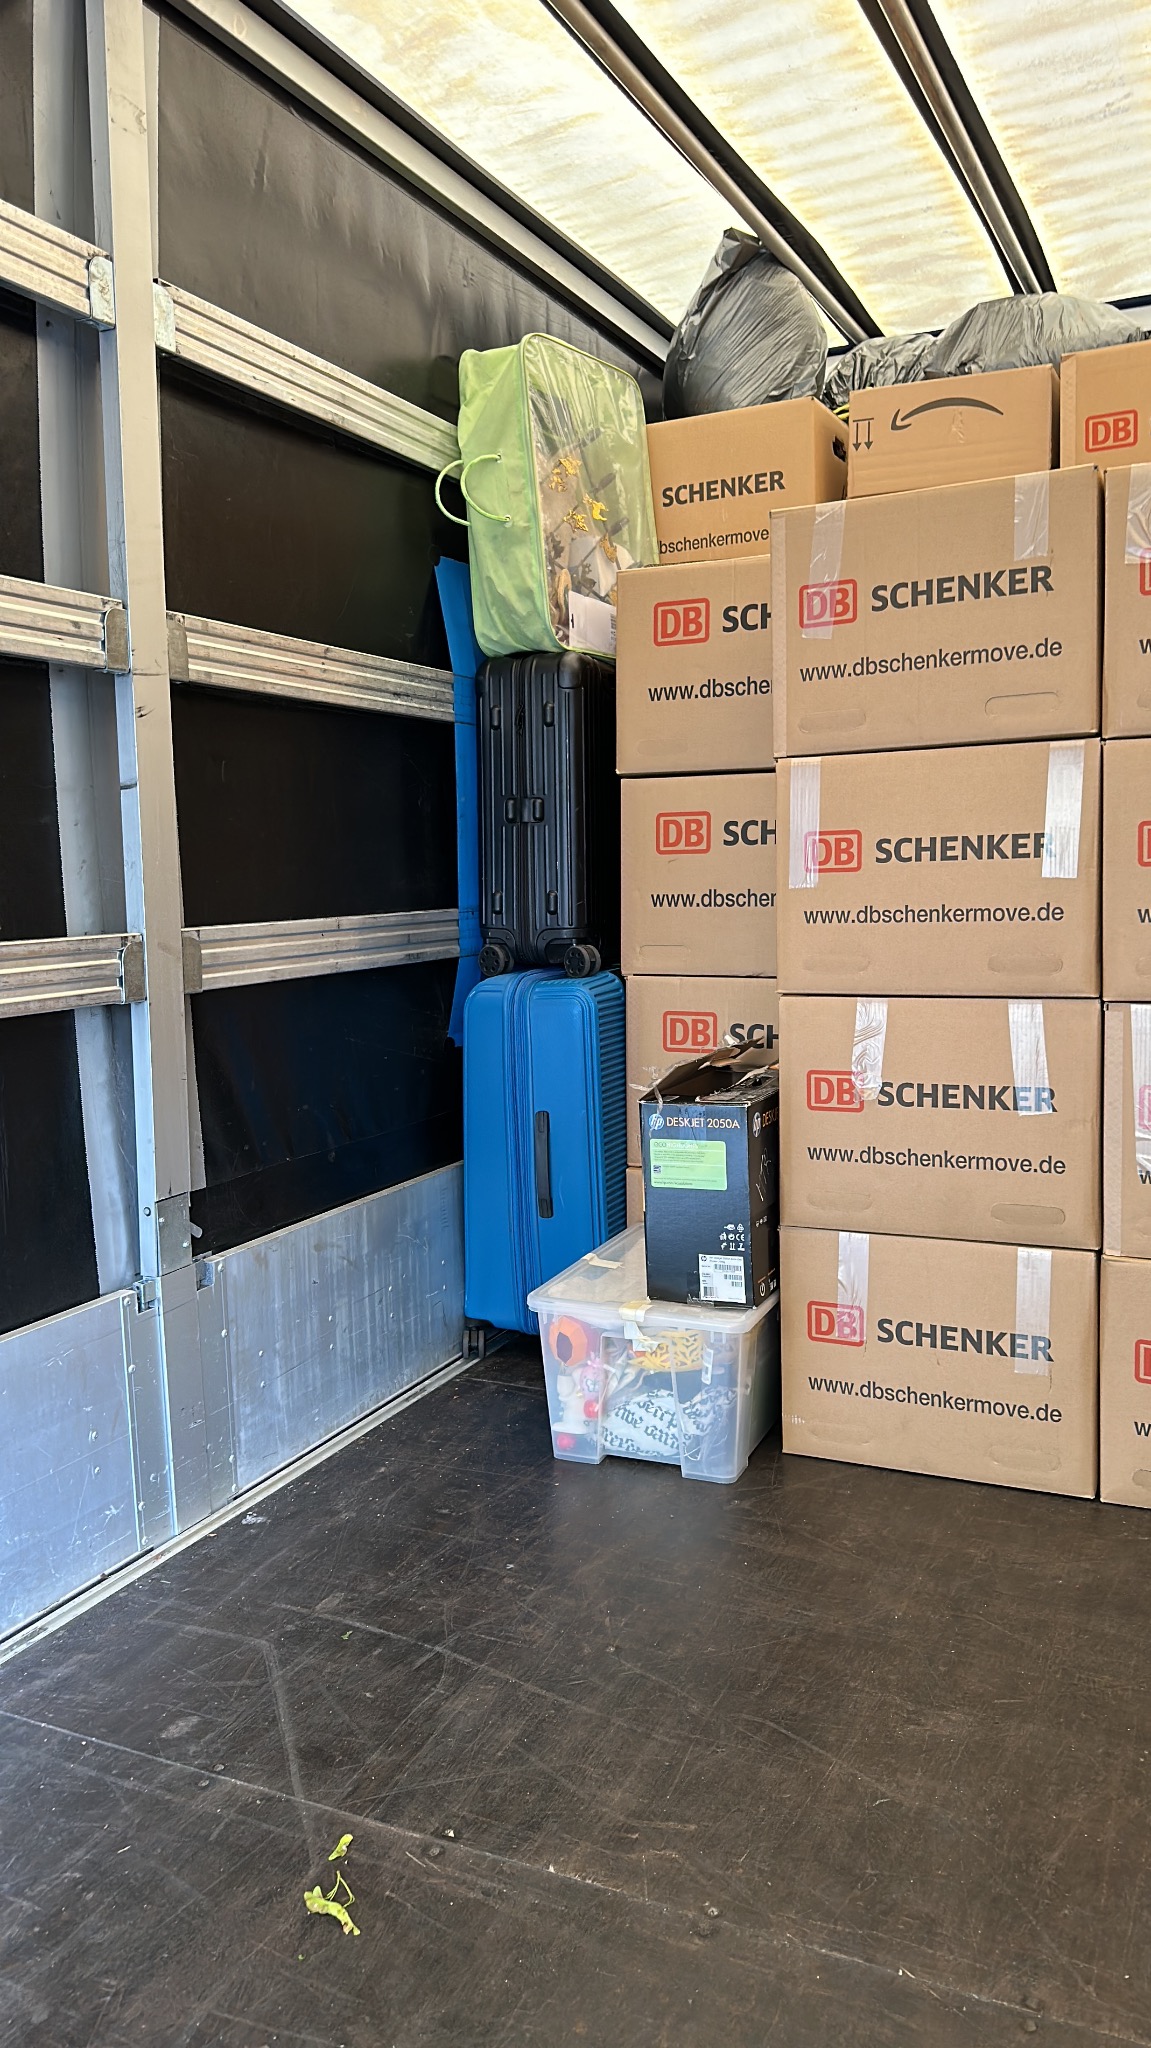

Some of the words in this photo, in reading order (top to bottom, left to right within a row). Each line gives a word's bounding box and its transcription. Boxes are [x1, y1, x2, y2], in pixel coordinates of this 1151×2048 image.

[1092, 417, 1131, 446] DB
[663, 471, 785, 507] SCHENKER
[806, 587, 850, 621] DB
[872, 566, 1054, 612] SCHENKER
[661, 606, 703, 639] DB
[800, 638, 1062, 682] www.dbschenkermove.de
[648, 676, 772, 702] www.dbsche
[663, 819, 704, 847] DB
[812, 837, 855, 866] DB
[875, 832, 1056, 863] SCHENKER
[804, 902, 1064, 924] www.dbschenkermove.de
[669, 1018, 711, 1046] DB
[814, 1077, 858, 1105] DB
[877, 1082, 1057, 1112] SCHENKER
[666, 1117, 705, 1128] DESKJET
[707, 1119, 740, 1129] 2050A
[807, 1146, 1065, 1174] www.dbschenkermove.de
[814, 1308, 857, 1338] DB
[877, 1319, 1054, 1362] SCHENKER
[808, 1376, 1062, 1422] www.dbschenkermove.de
